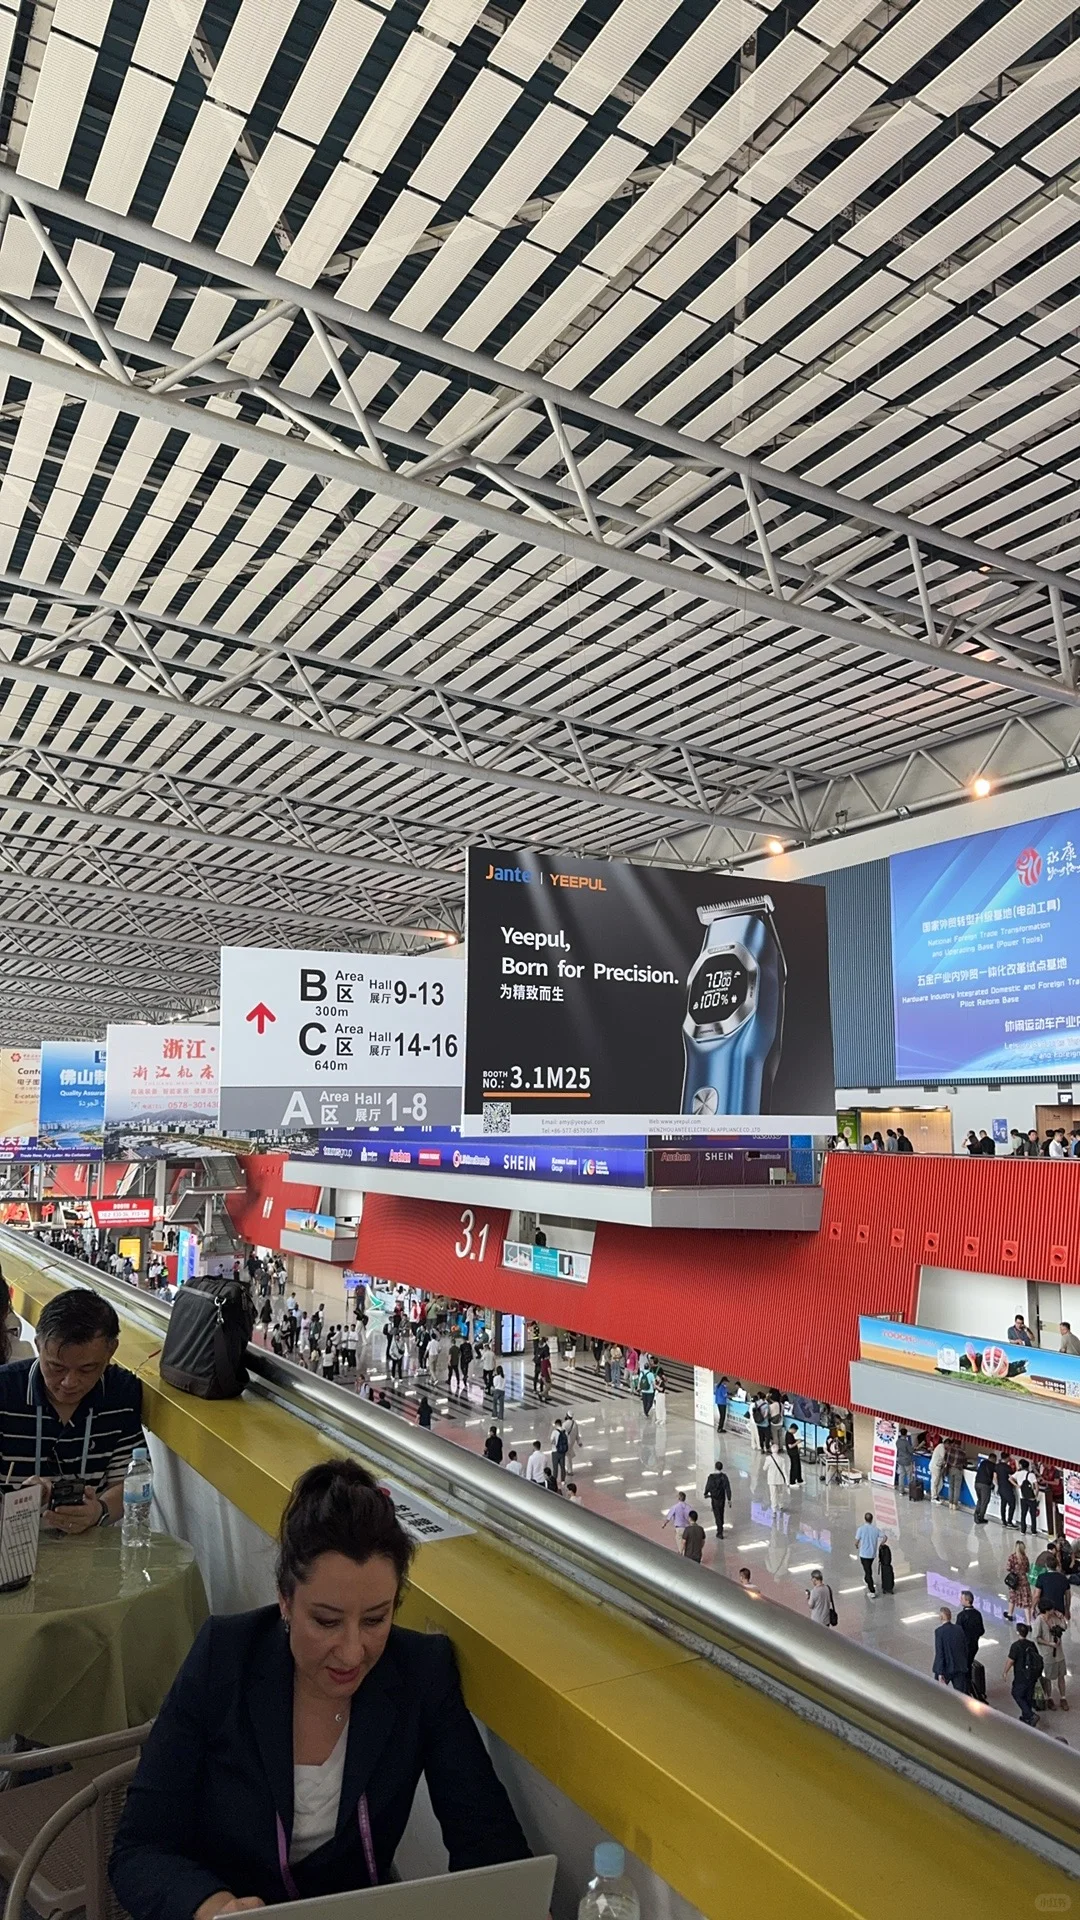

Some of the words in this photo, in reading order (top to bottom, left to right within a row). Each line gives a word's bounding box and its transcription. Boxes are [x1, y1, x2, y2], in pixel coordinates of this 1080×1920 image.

[486, 865, 531, 883] Jante
[550, 873, 607, 891] YEEPUL
[1001, 921, 1051, 935] Transformation
[500, 926, 571, 952] Yeepul,
[996, 938, 1019, 949] (Power
[1021, 933, 1043, 945] Tools)
[502, 957, 548, 976] Born
[557, 960, 585, 978] for
[594, 963, 679, 984] Precision.
[300, 968, 328, 1001] B
[335, 970, 364, 982] Area
[337, 984, 354, 1003] 区
[369, 980, 392, 990] Hall
[394, 980, 444, 1006] 9-13
[500, 983, 564, 1002] 为精致而生
[902, 993, 928, 1004] Hardware
[930, 991, 955, 1002] Industry
[957, 987, 988, 999] Integrated
[991, 984, 1020, 994] Domestic
[1023, 981, 1035, 991] and
[1038, 978, 1065, 990] Foreign
[369, 992, 391, 1004] 展厅
[960, 999, 975, 1008] Pilot
[977, 998, 999, 1007] Reform
[1002, 995, 1019, 1004] Base
[315, 1006, 349, 1017] 300m
[299, 1022, 327, 1056] C
[335, 1023, 364, 1035] Area
[336, 1037, 354, 1056] 区
[369, 1032, 391, 1042] Hall
[394, 1032, 458, 1058] 14-16
[369, 1045, 391, 1056] 展厅
[314, 1060, 348, 1071] 640m
[483, 1078, 504, 1089] NO.:
[510, 1065, 591, 1089] 3.1M25
[60, 1090, 82, 1098] Quality
[280, 1091, 314, 1126] A
[319, 1091, 349, 1103] Area
[354, 1092, 381, 1105] Hall
[386, 1093, 427, 1121] 1-8
[321, 1105, 339, 1125] 区
[354, 1109, 381, 1122] 展厅
[503, 1154, 536, 1171] SHEIN
[705, 1152, 734, 1161] SHEIN
[455, 1209, 490, 1262] 3.1
